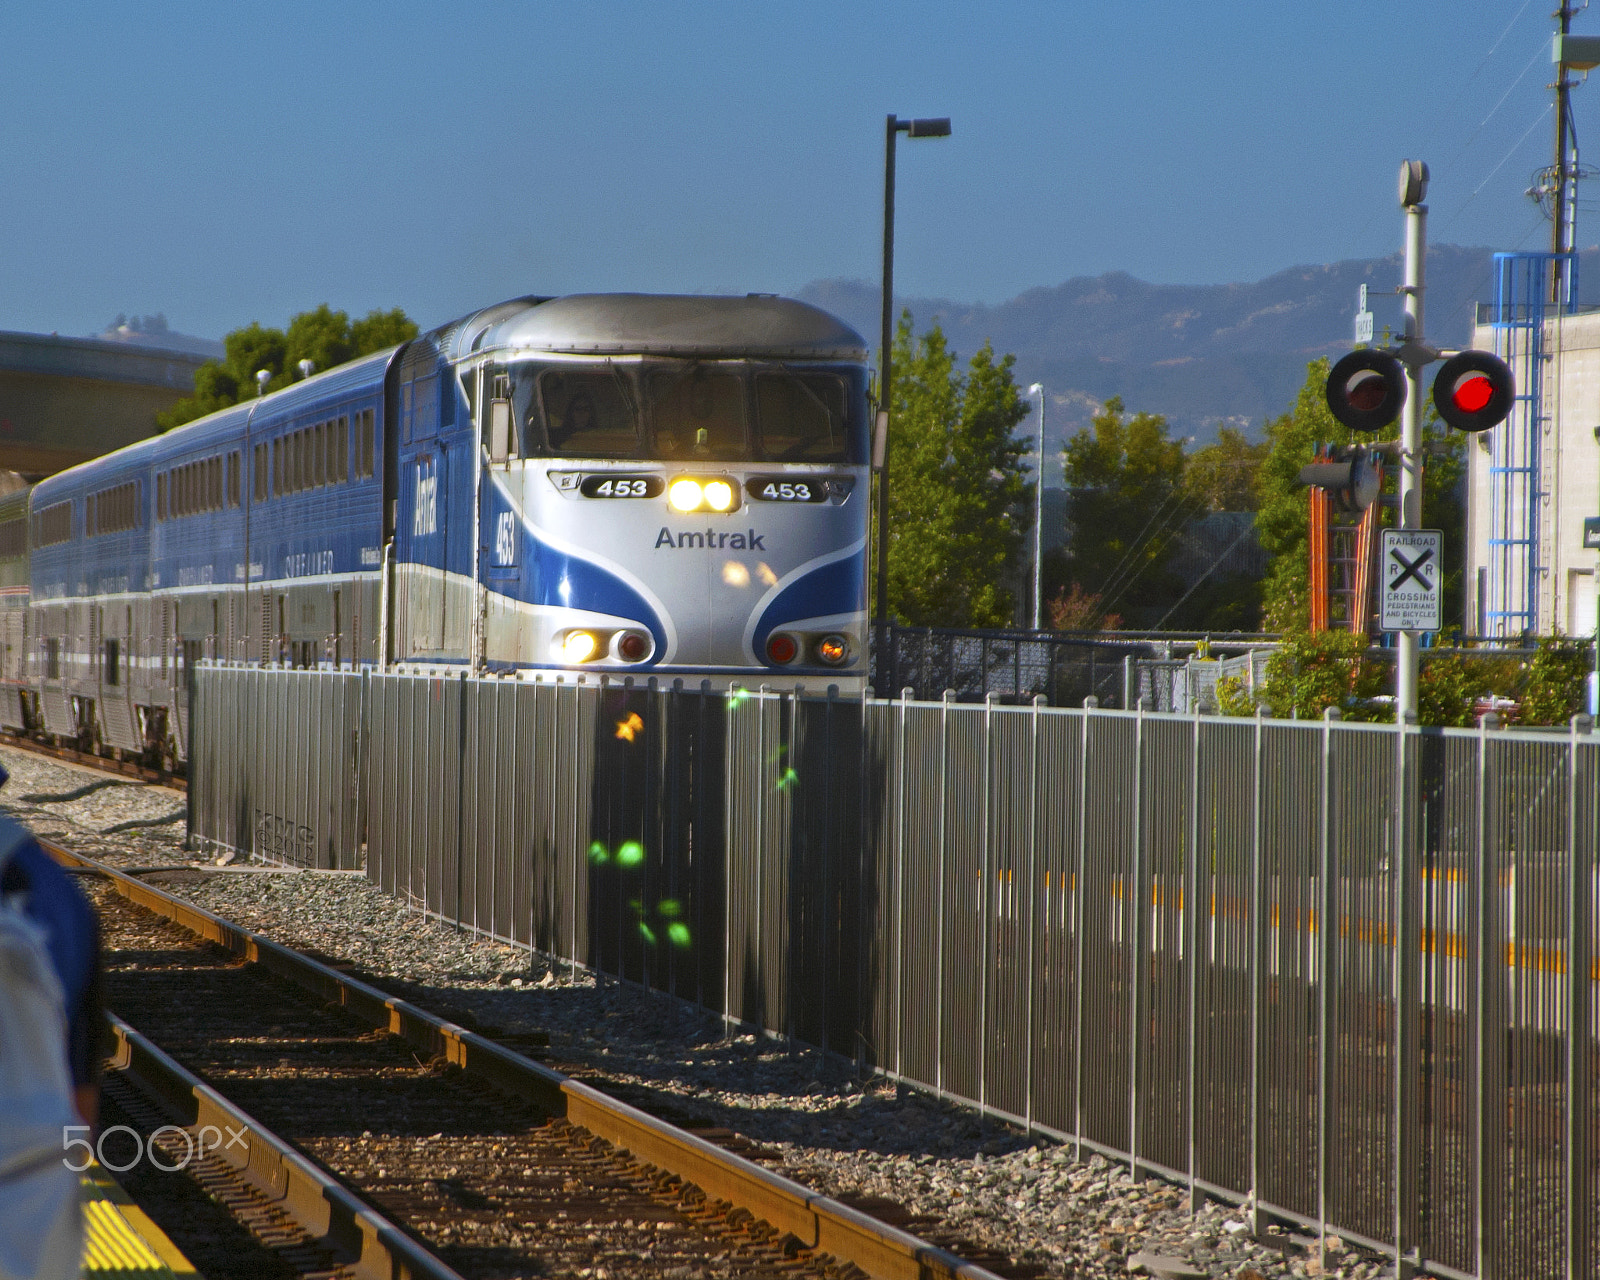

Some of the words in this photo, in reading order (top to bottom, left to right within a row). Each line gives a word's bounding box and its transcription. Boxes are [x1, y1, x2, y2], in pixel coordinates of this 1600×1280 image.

[596, 480, 647, 497] 453
[762, 483, 811, 500] 453
[497, 510, 515, 565] 453
[654, 526, 767, 551] Amtrak
[1389, 537, 1436, 546] RAILROAD
[1390, 563, 1399, 575] R
[1425, 564, 1433, 575] R
[1387, 593, 1436, 601] CROSSING
